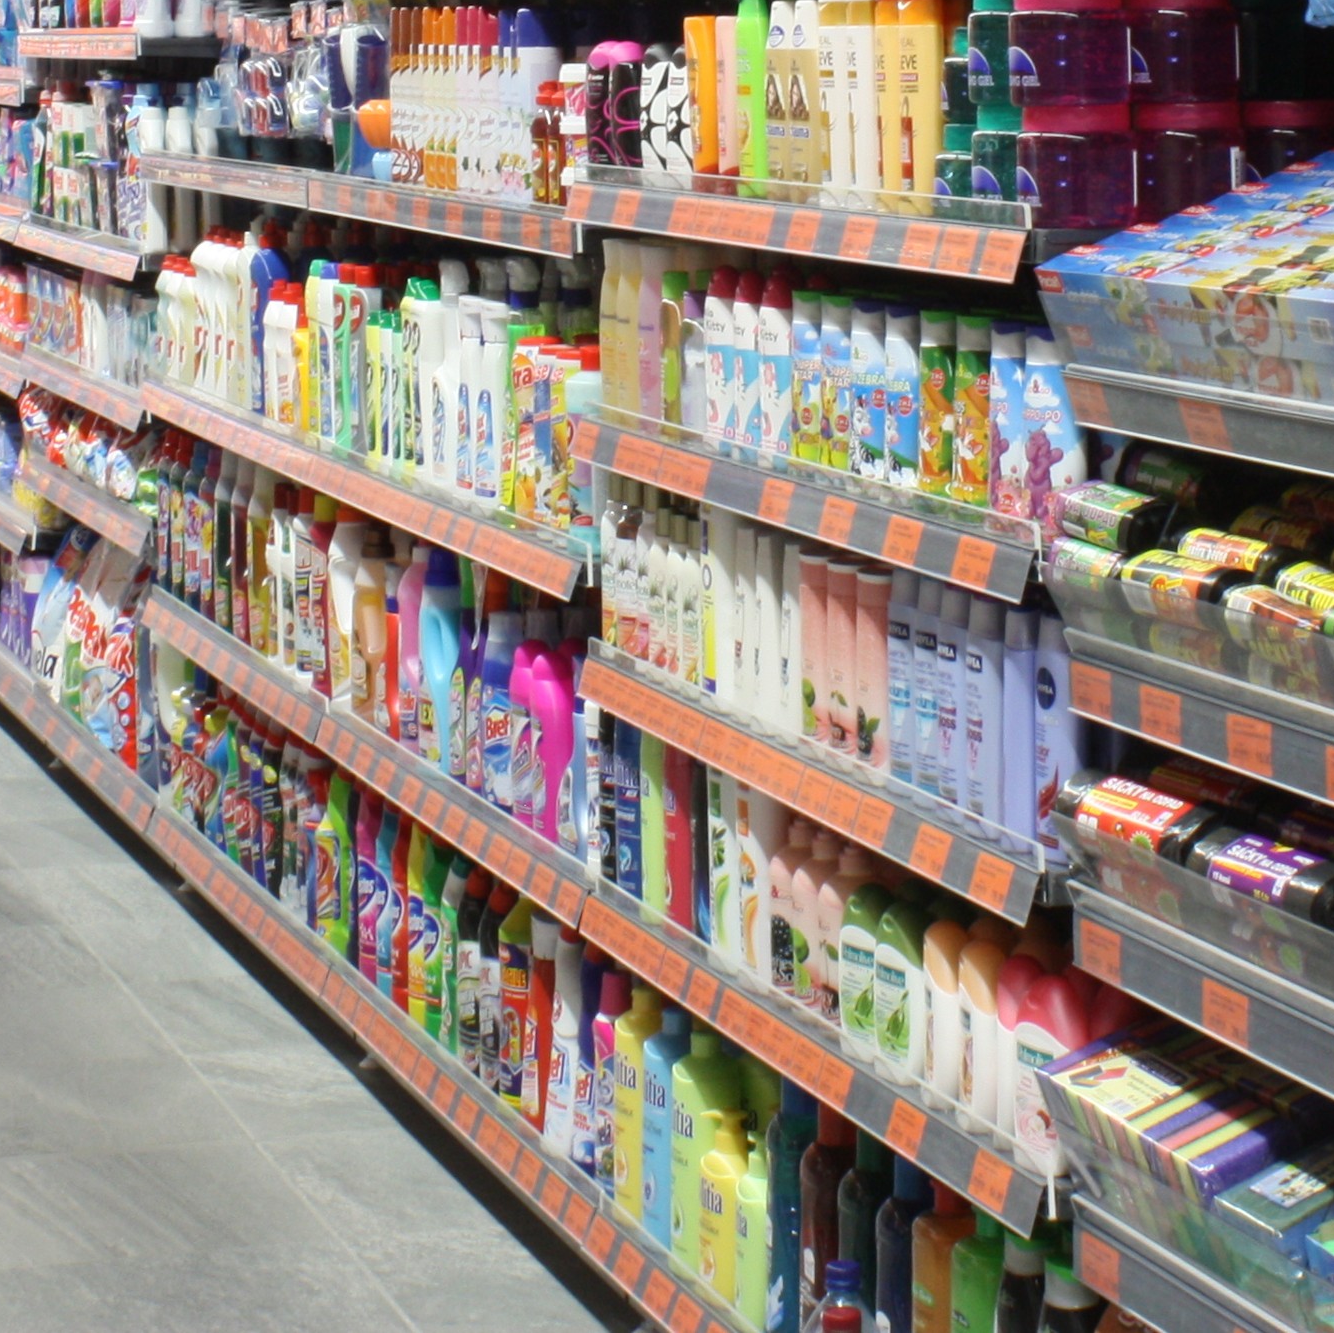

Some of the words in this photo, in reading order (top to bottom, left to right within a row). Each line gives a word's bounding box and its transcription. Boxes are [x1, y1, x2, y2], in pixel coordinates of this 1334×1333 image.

[484, 716, 510, 739] Bref
[1101, 774, 1143, 801] SÁČKY
[1142, 788, 1155, 801] NA
[1155, 792, 1185, 811] ODPAD
[1226, 840, 1267, 866] SÁČKY
[644, 1070, 666, 1109] itia
